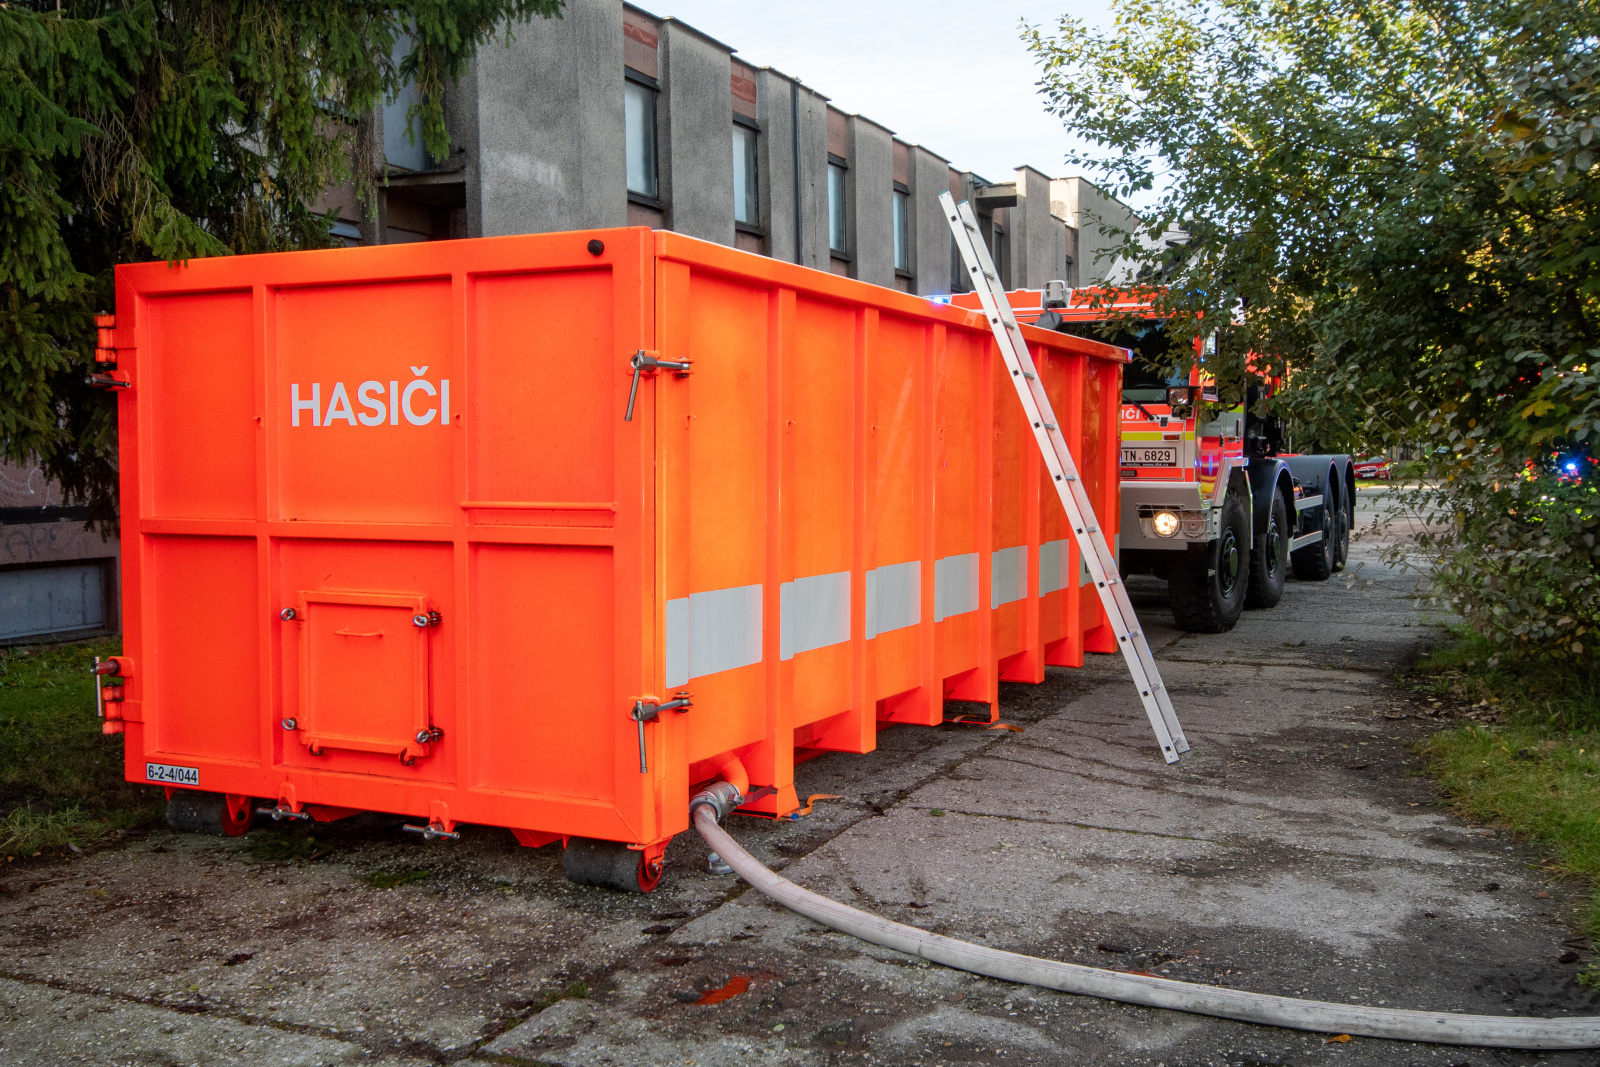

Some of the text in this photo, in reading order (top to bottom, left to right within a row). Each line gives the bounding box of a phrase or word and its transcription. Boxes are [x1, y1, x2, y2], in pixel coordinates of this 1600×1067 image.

[291, 366, 450, 427] HASIČI
[1121, 407, 1141, 420] IČI
[1144, 450, 1171, 462] 6829
[148, 765, 198, 784] 6-2-4/044
